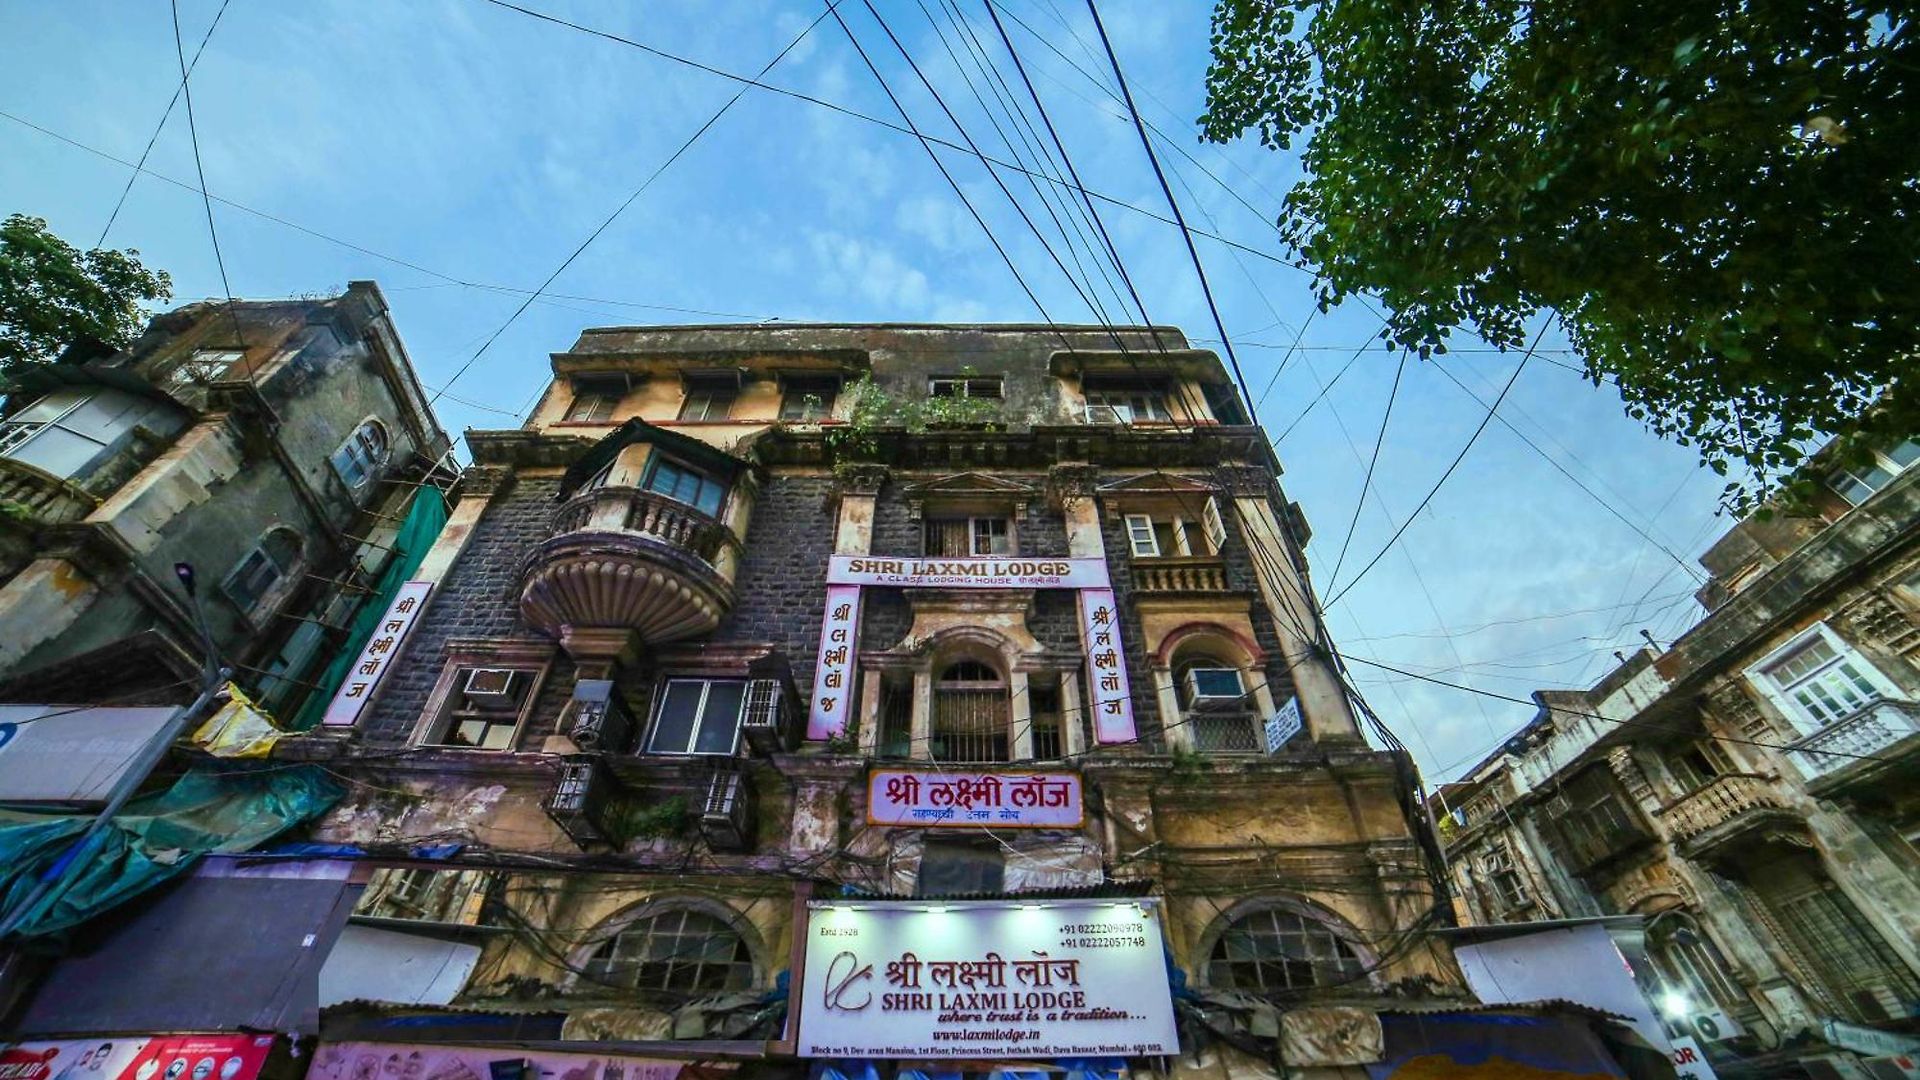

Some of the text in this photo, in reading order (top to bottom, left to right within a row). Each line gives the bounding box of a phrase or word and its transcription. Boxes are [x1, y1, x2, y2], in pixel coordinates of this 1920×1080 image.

[848, 560, 1070, 577] SHRI LAXMI LODGE
[975, 577, 1012, 585] HOUSE
[395, 597, 417, 614] श्री
[1091, 606, 1108, 625] श्री
[886, 775, 1070, 810] श्री लक्ष्मी लॉज
[885, 952, 923, 990] श्री
[928, 952, 1006, 992] लक्ष्मी
[1012, 950, 1080, 988] लॉज
[882, 991, 1086, 1011] SHRI LAXMI LODGE
[937, 1011, 982, 1024] where
[985, 1010, 1022, 1022] trust
[1026, 1009, 1040, 1022] is
[1046, 1012, 1057, 1022] a
[932, 1029, 1040, 1043] www.laxmilodge.in
[1099, 1044, 1126, 1052] Mumbai
[1672, 1047, 1699, 1066] OR
